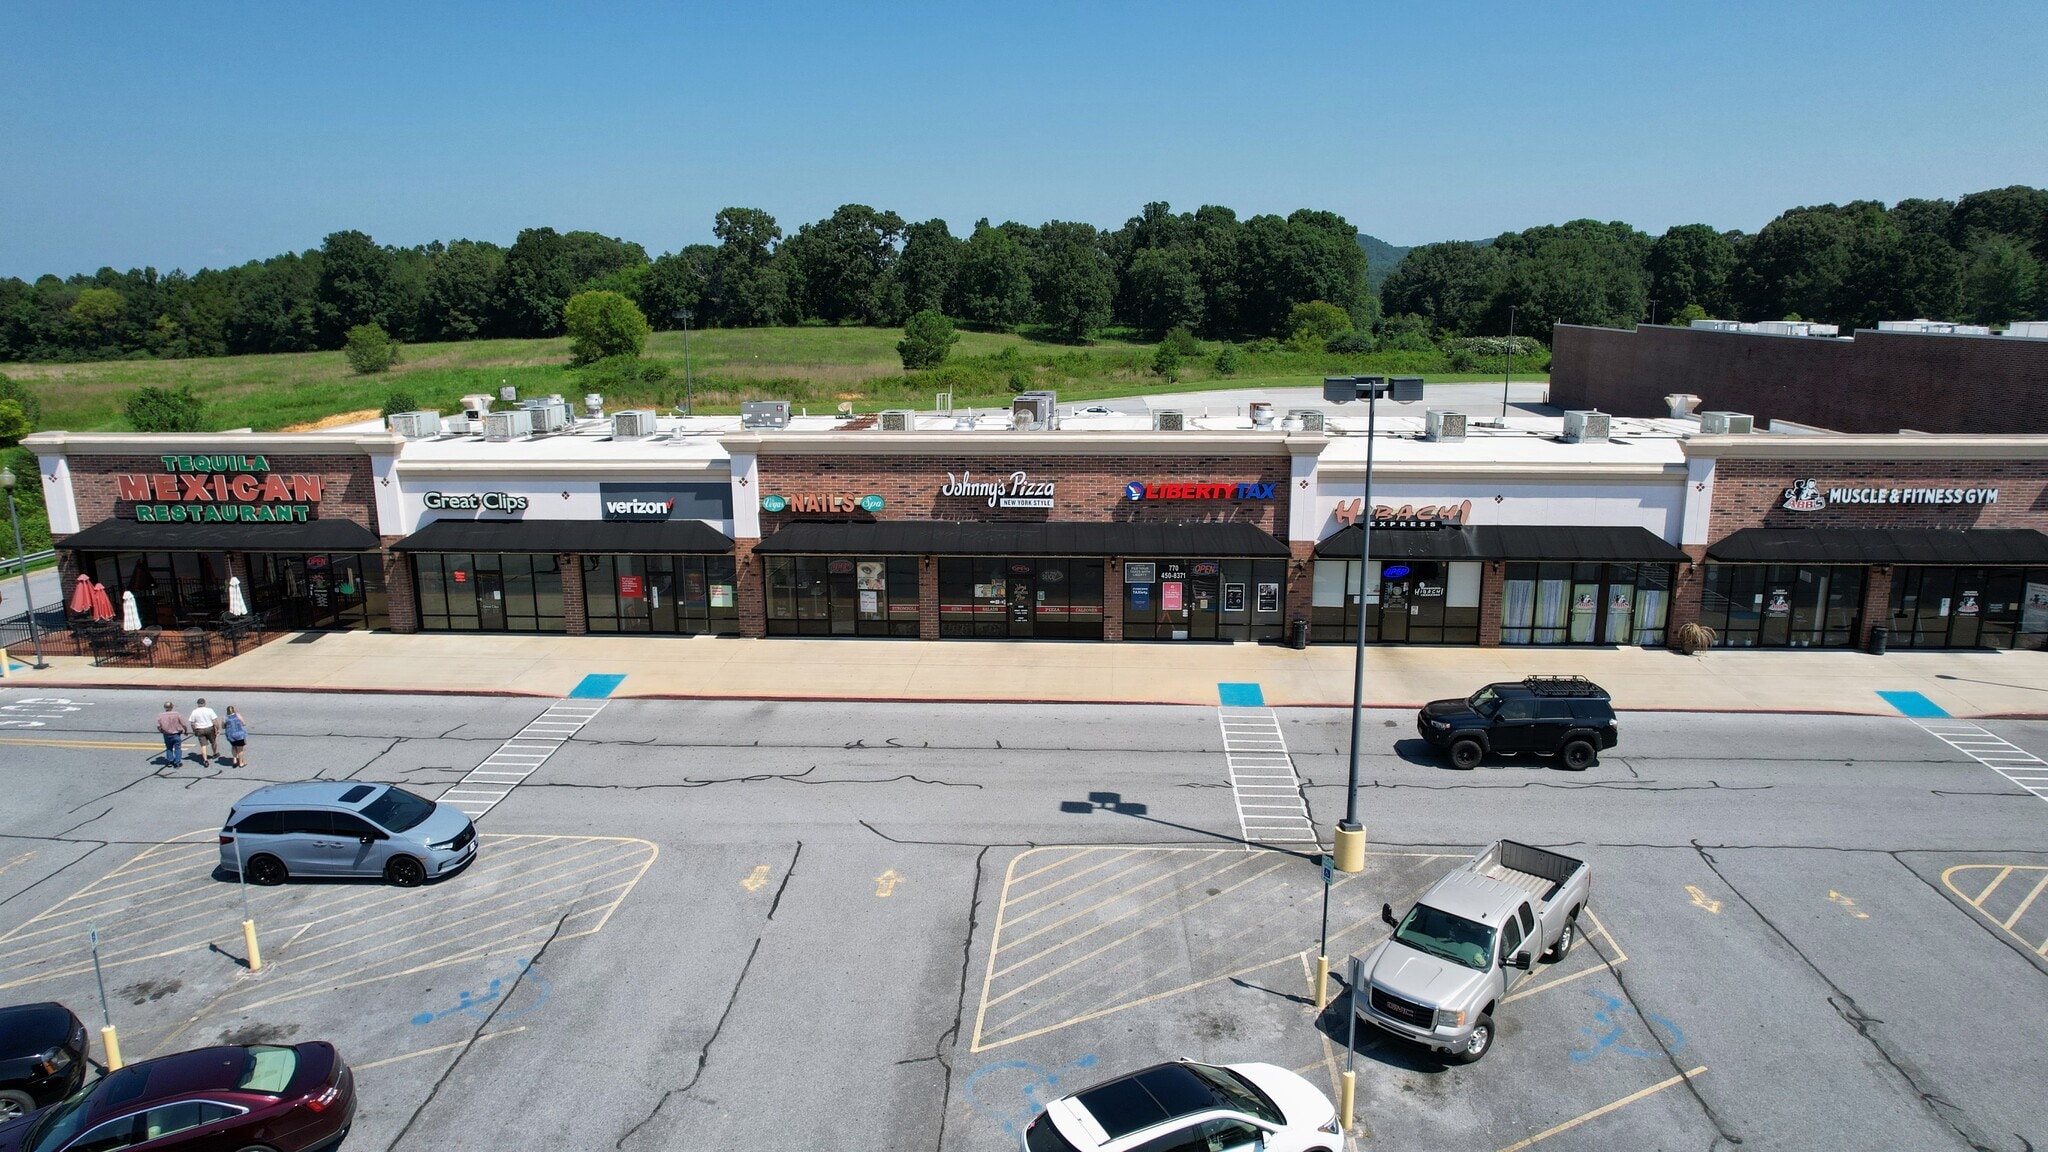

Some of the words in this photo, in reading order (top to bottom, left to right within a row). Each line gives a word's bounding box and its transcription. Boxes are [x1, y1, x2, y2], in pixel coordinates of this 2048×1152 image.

[161, 455, 270, 472] TEQUILA
[118, 474, 322, 501] MEXICAN
[942, 471, 1006, 507] Johnny's
[1009, 471, 1055, 496] Pizza
[1829, 488, 1887, 504] MUSCLE
[1889, 488, 1900, 504] &
[1902, 488, 1964, 504] FITNESS
[1965, 488, 1998, 504] GYM
[423, 491, 479, 509] Great
[481, 492, 528, 514] Clips
[606, 498, 668, 514] verizon
[763, 496, 785, 509] Vegas
[790, 492, 855, 513] NAILS
[862, 496, 882, 509] Spa
[136, 505, 309, 522] RESTAURANT
[1335, 498, 1472, 526] HBACHI
[1195, 565, 1216, 574] OPEN
[1385, 568, 1407, 576] OPEN
[1414, 588, 1443, 596] HIBACHI
[1387, 1001, 1414, 1017] GMC
